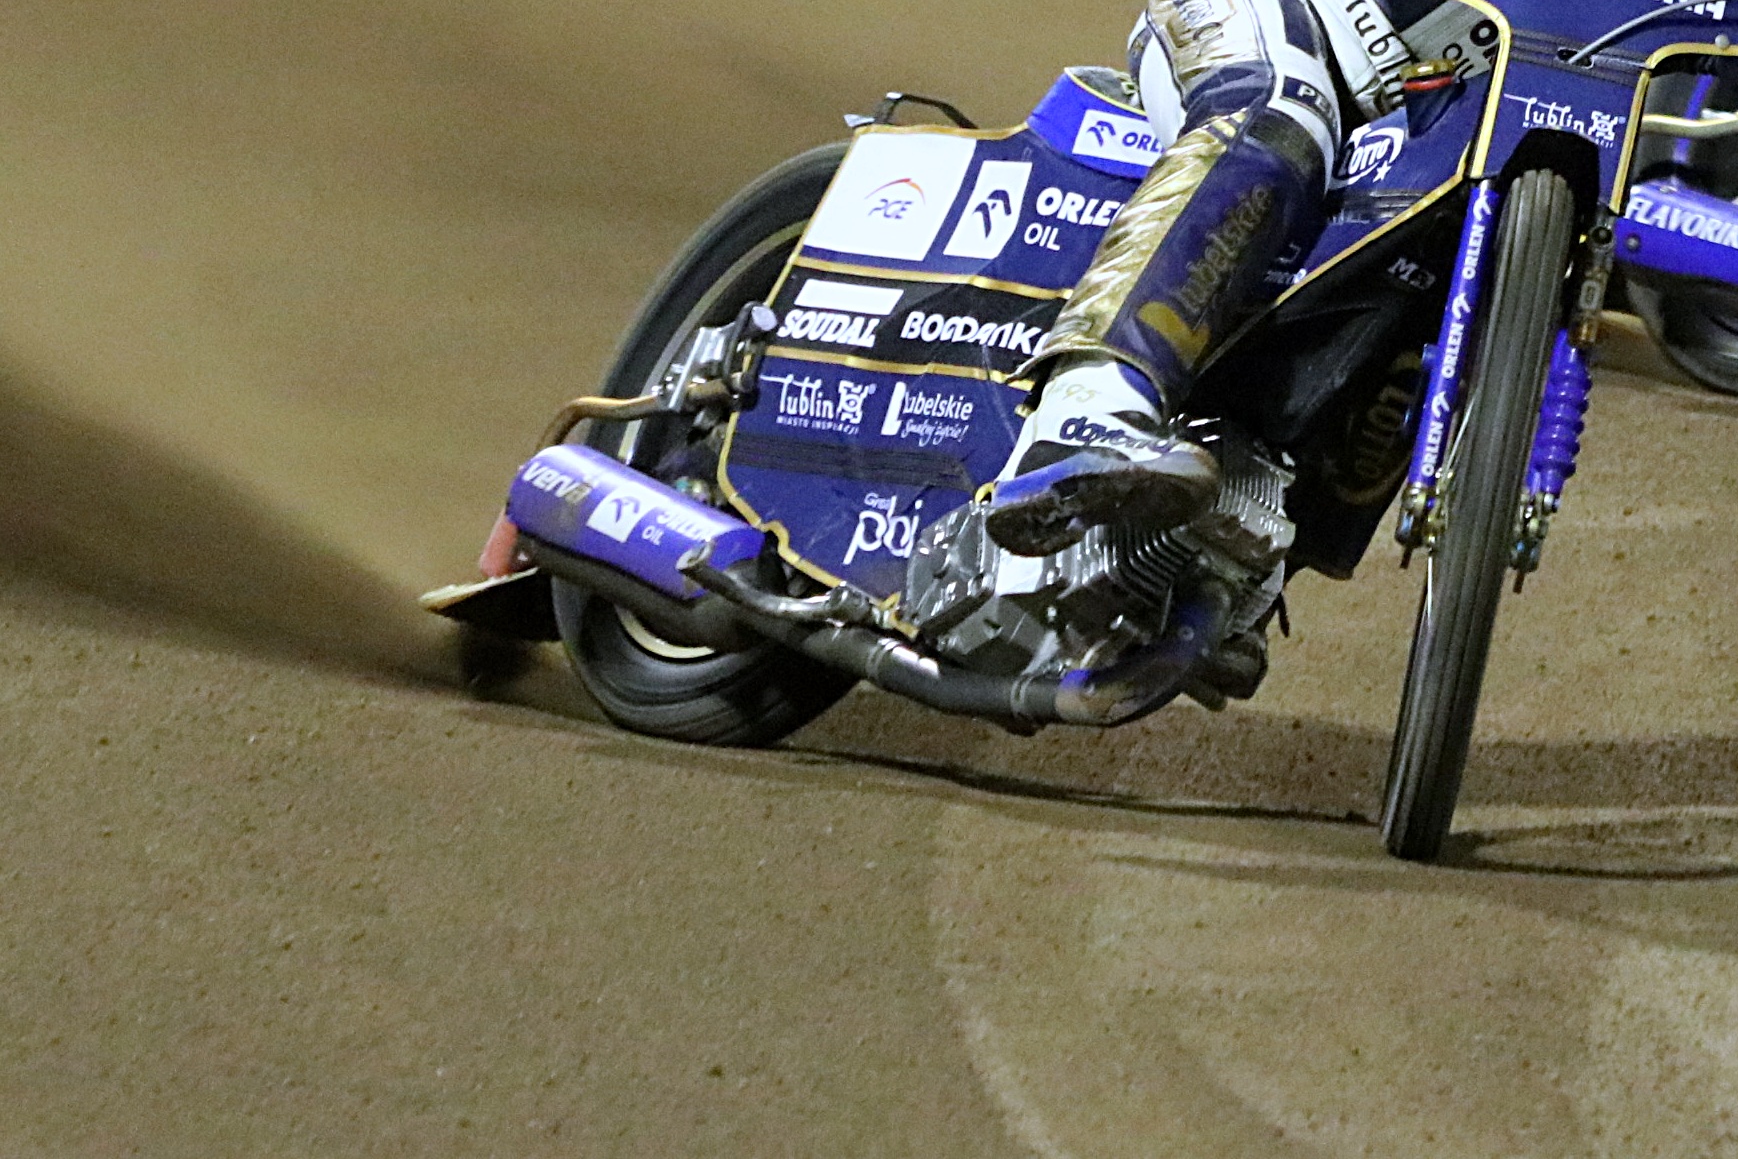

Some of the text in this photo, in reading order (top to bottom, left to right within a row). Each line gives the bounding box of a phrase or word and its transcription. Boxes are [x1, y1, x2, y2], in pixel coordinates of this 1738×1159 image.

[1122, 132, 1166, 154] ORL
[867, 197, 914, 220] PGE
[1023, 222, 1061, 252] OIL
[1461, 224, 1486, 280] ORLEN
[776, 308, 882, 348] SOUDAL
[1441, 322, 1464, 379] ORLEN
[1420, 420, 1444, 478] ORLEN
[641, 524, 665, 546] OIL
